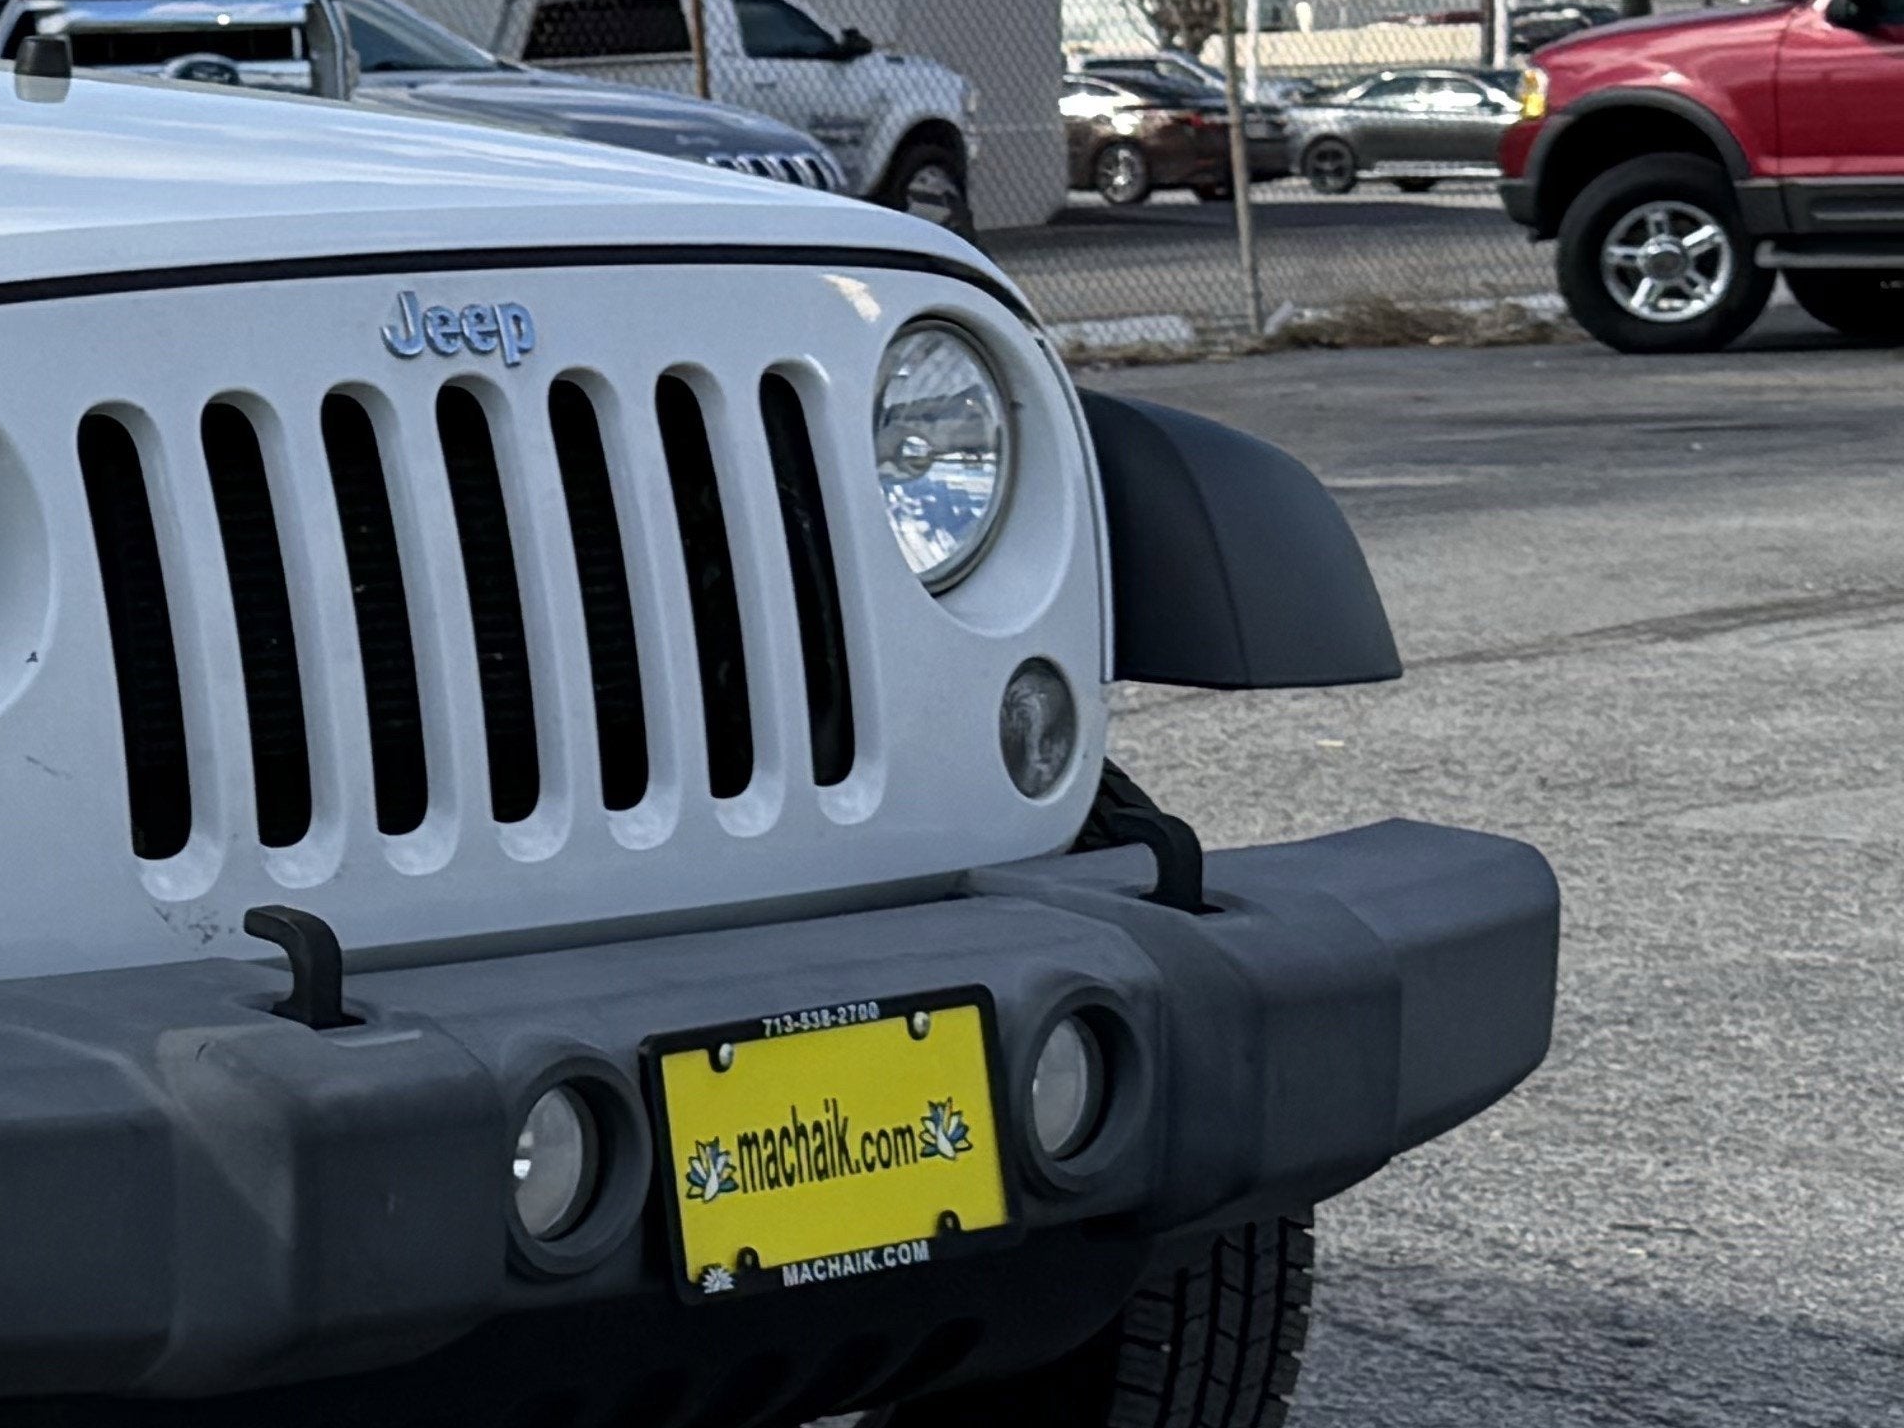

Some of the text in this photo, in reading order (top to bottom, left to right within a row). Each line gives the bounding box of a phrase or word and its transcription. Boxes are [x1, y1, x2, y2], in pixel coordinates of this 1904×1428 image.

[381, 290, 536, 367] Jeep
[737, 1098, 919, 1193] machaik.com
[782, 1240, 930, 1287] MACHAIK.COM
